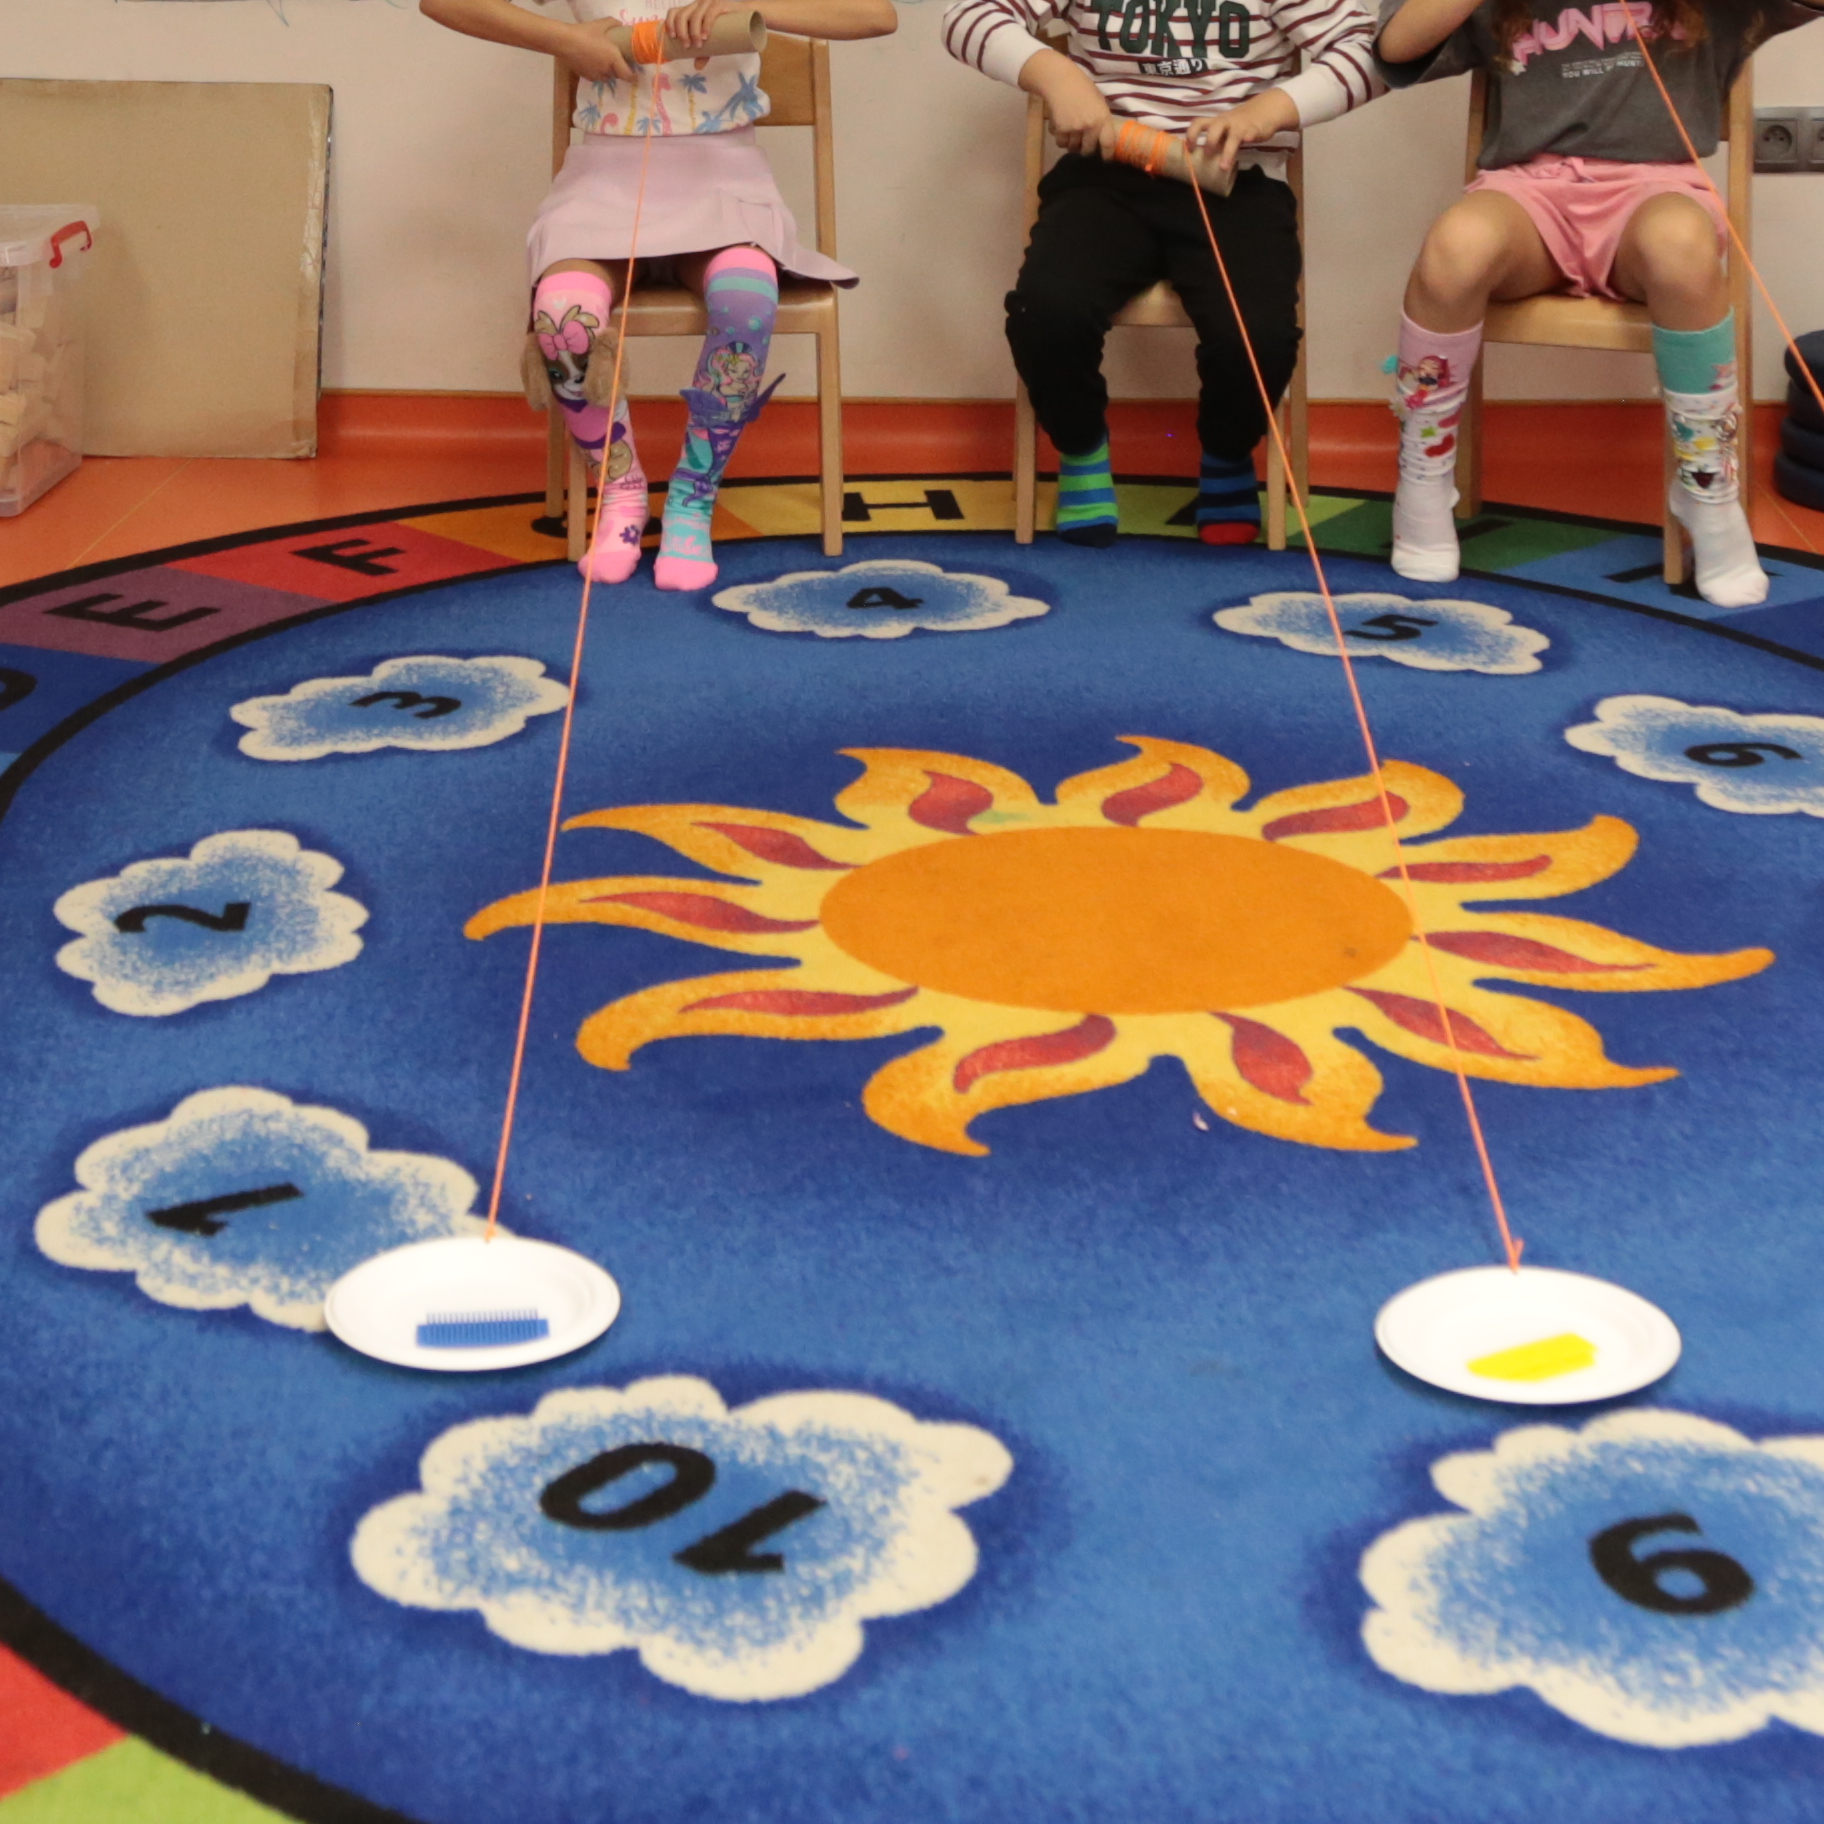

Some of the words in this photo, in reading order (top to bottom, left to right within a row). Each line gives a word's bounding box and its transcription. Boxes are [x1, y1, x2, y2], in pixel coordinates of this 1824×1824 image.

[1142, 58, 1204, 77] 東京通り
[841, 489, 964, 522] H
[288, 537, 407, 577] F
[42, 591, 222, 633] E
[845, 586, 924, 611] 4
[1344, 613, 1436, 644] 5
[348, 689, 462, 720] 3
[113, 901, 251, 936] 2
[142, 1181, 302, 1237] 1
[537, 1441, 829, 1578] 10
